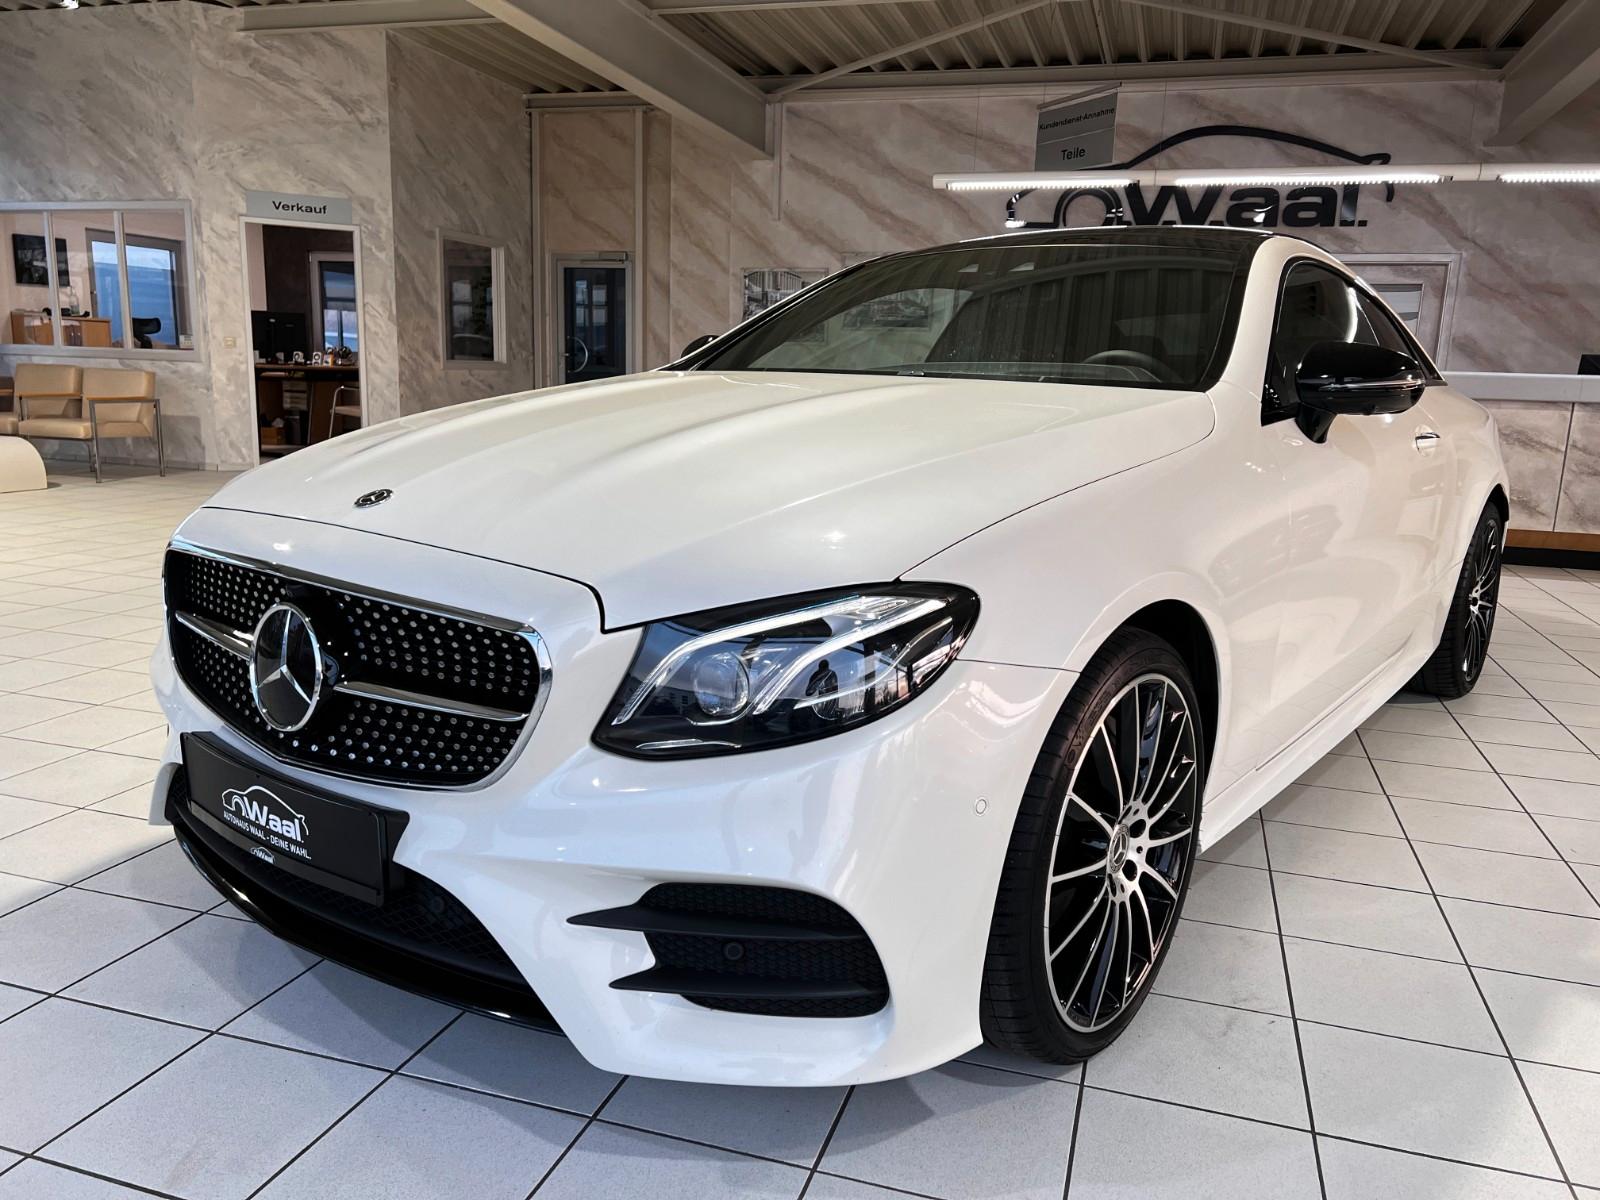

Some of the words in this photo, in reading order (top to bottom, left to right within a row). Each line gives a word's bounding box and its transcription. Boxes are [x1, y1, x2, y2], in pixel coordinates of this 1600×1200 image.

[1061, 147, 1086, 160] Teile
[272, 200, 327, 214] Verkauf
[223, 810, 250, 831] AUTOHAUS
[250, 825, 267, 840] WAAL
[270, 835, 289, 851] DEINE
